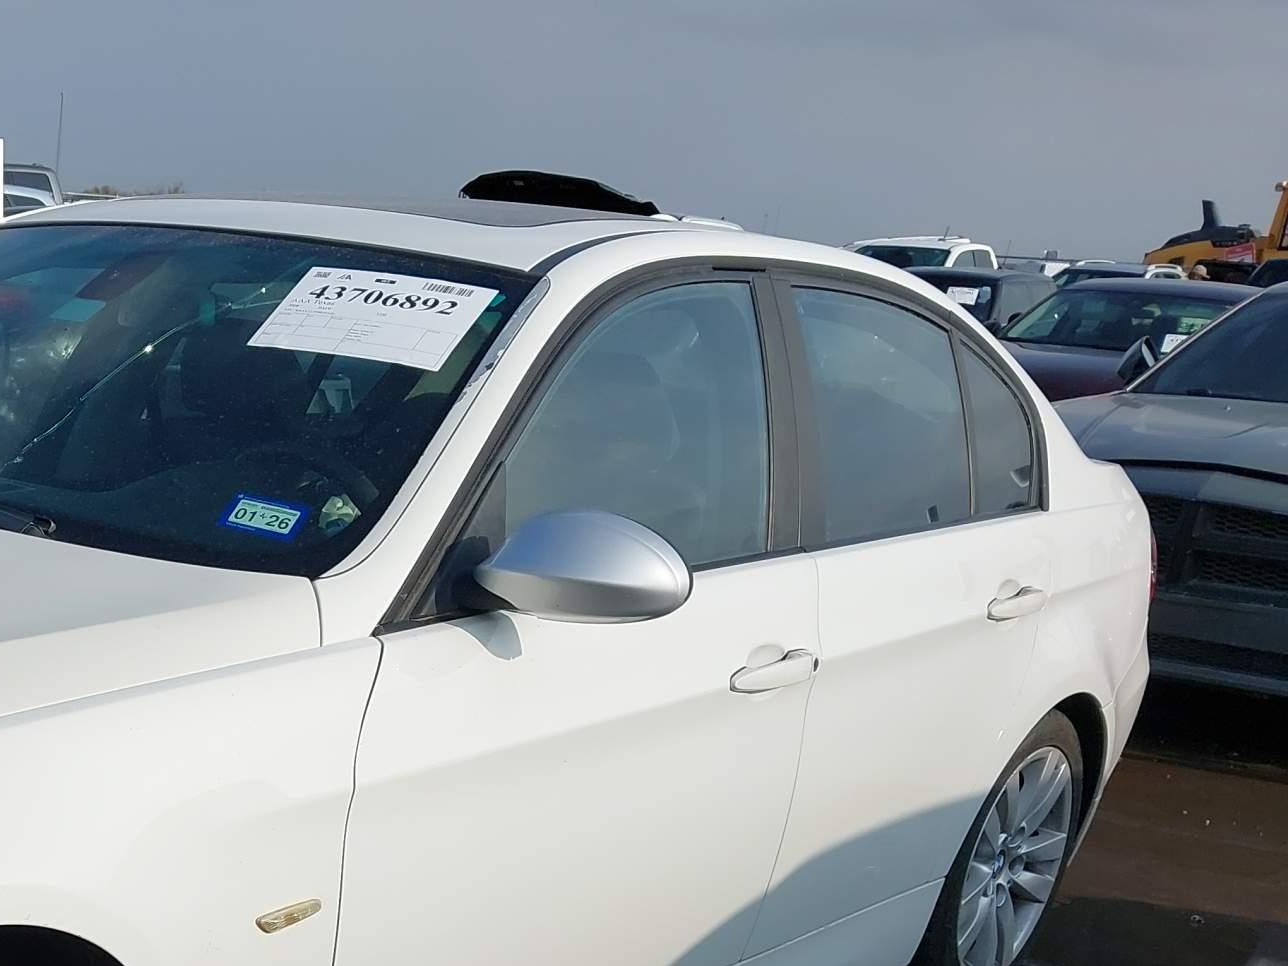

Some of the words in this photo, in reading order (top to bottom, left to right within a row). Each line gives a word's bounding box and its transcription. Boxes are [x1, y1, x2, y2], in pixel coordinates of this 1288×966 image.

[308, 283, 459, 316] 43706892
[234, 507, 258, 522] 01
[265, 514, 292, 530] 26
